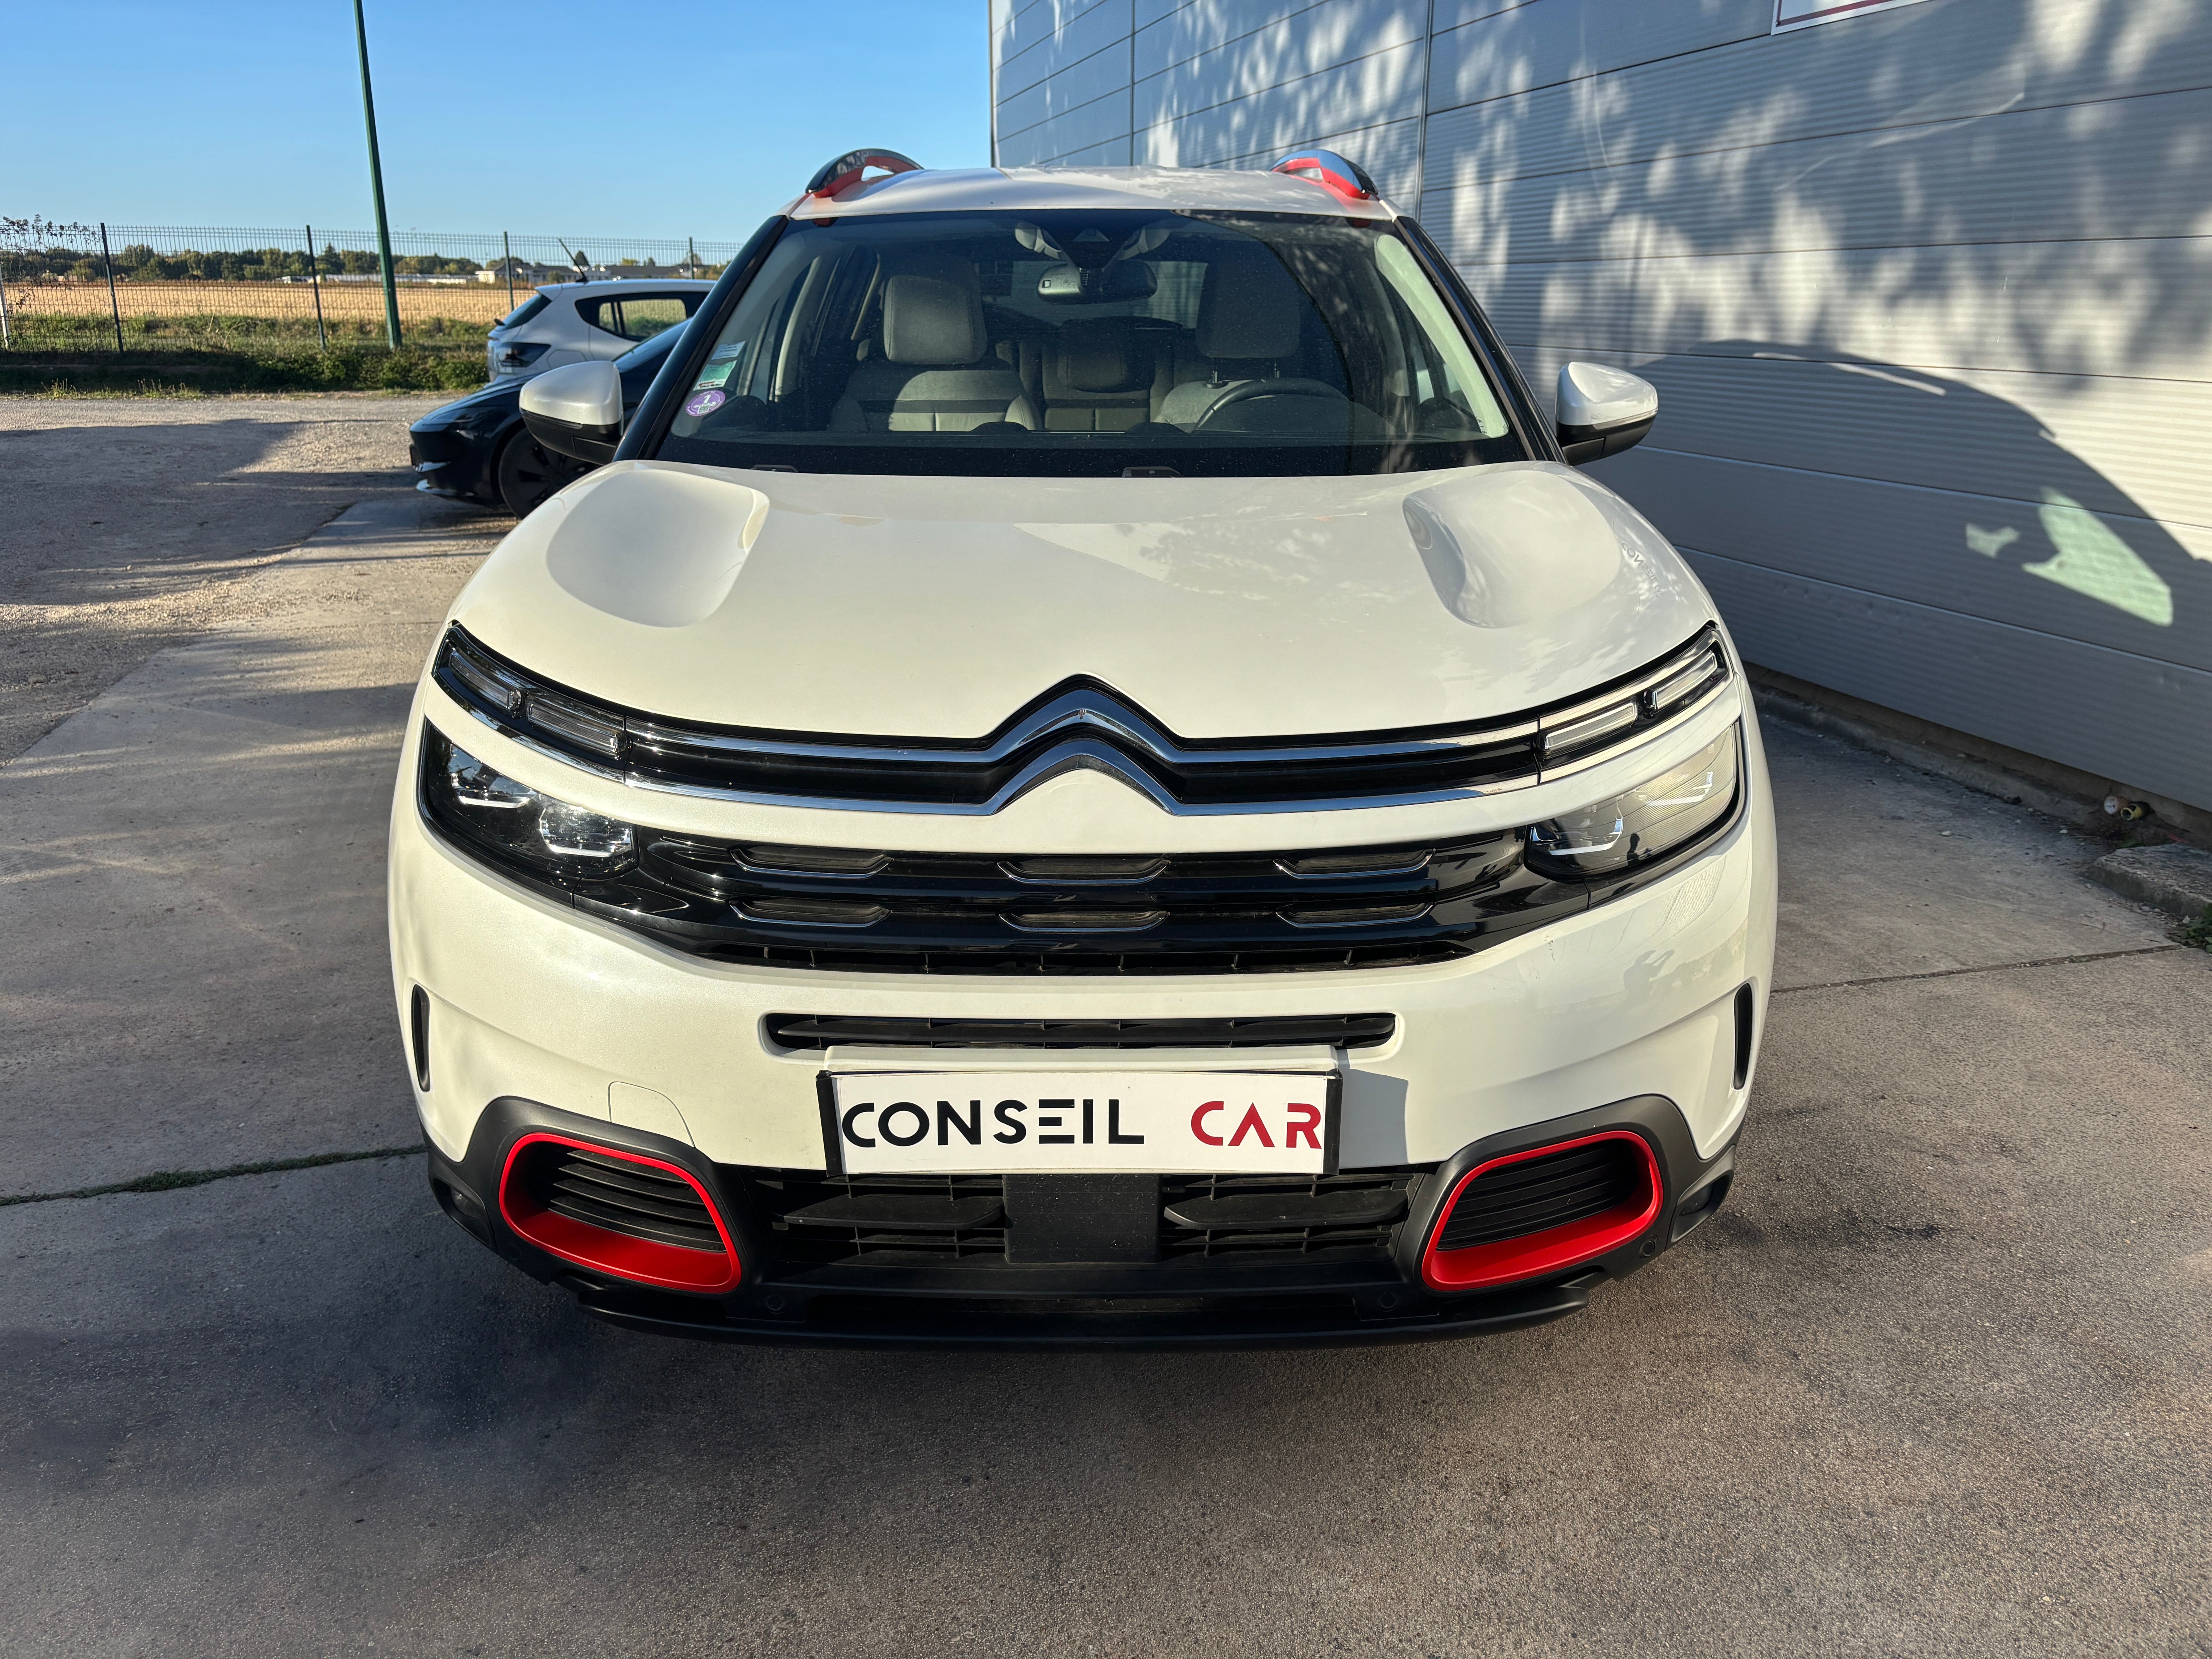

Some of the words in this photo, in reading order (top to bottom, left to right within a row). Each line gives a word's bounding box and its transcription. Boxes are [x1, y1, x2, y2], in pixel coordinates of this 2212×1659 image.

[704, 395, 711, 404] 1
[842, 1099, 1144, 1148] CONSEIL
[1191, 1101, 1322, 1149] CAR
